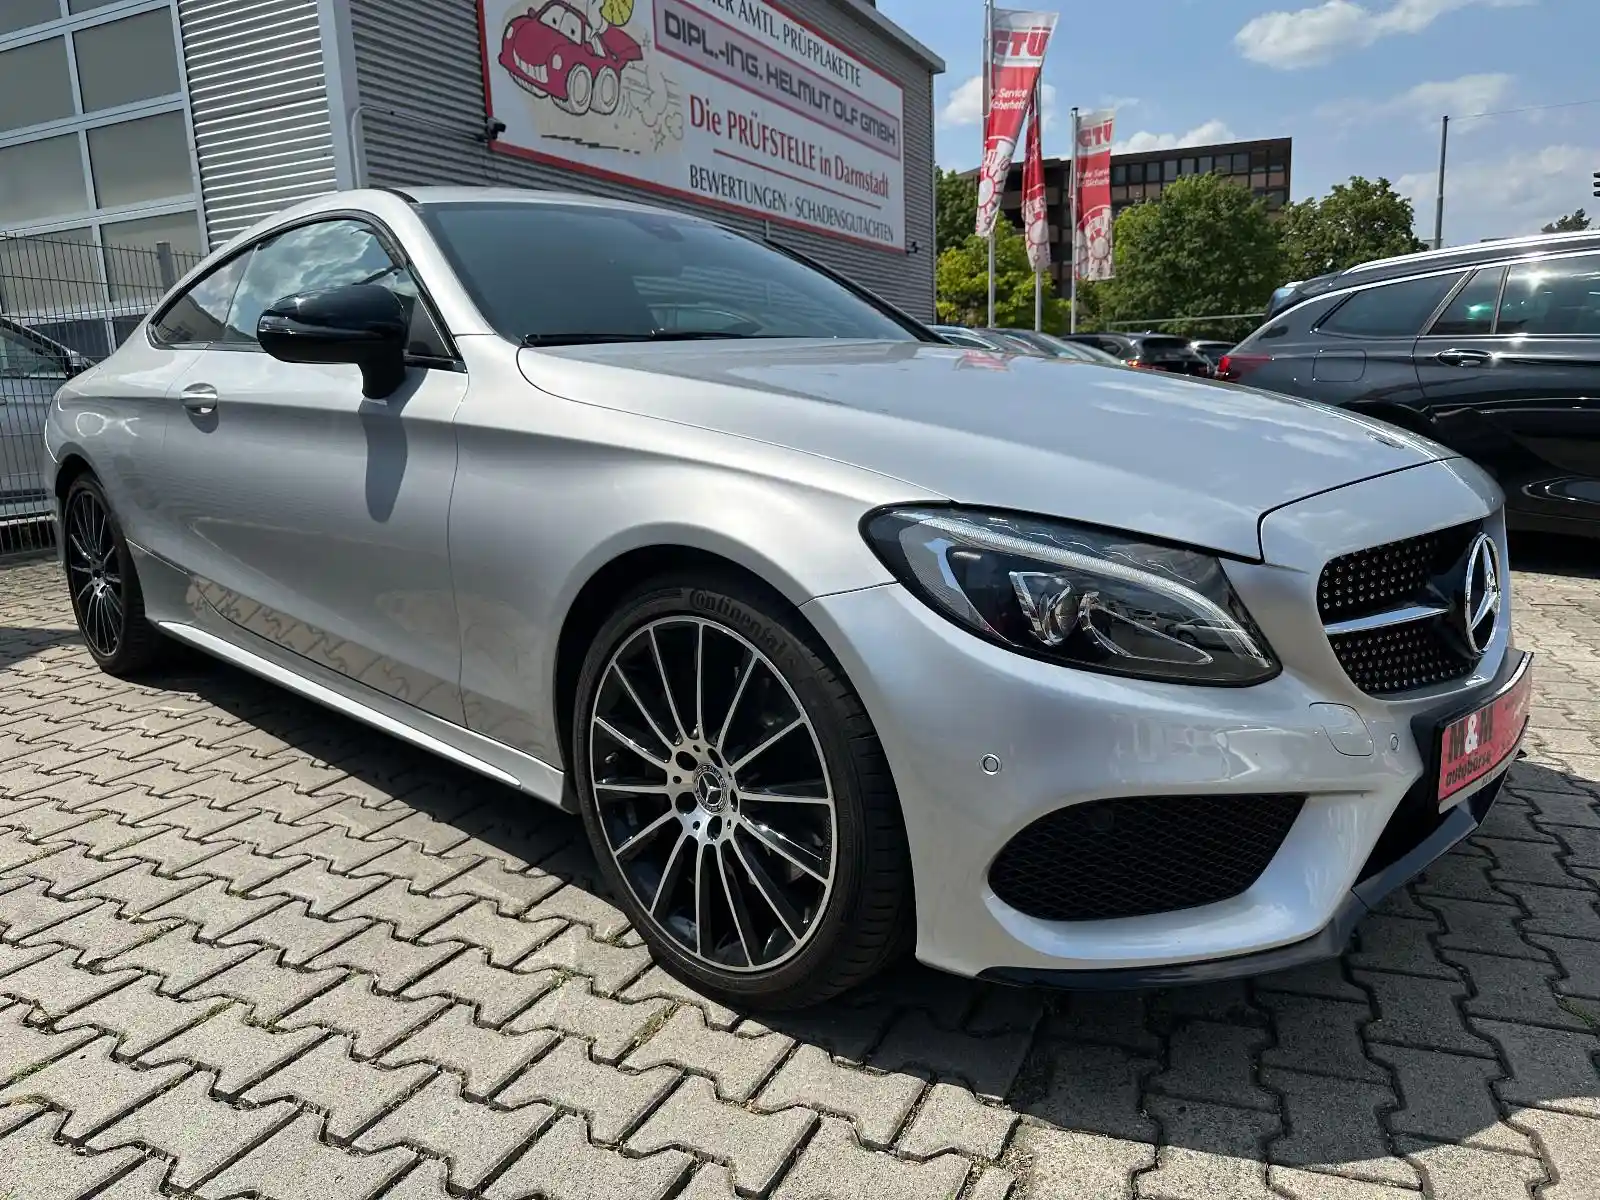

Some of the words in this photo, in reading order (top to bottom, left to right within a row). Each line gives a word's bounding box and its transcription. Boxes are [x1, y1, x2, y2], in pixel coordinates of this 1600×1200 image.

[738, 0, 780, 41] AMTL.
[783, 23, 862, 88] PRÜFPLAKETTE
[765, 61, 832, 114] HELMUT
[833, 96, 859, 126] OLF
[689, 94, 722, 136] Die
[727, 109, 816, 171] PRÜFSTELLE
[820, 146, 832, 177] in
[834, 155, 889, 199] Darmstadt
[689, 164, 788, 212] BEWERTUNGEN
[795, 195, 894, 242] SCHADENSGUTACHTEN
